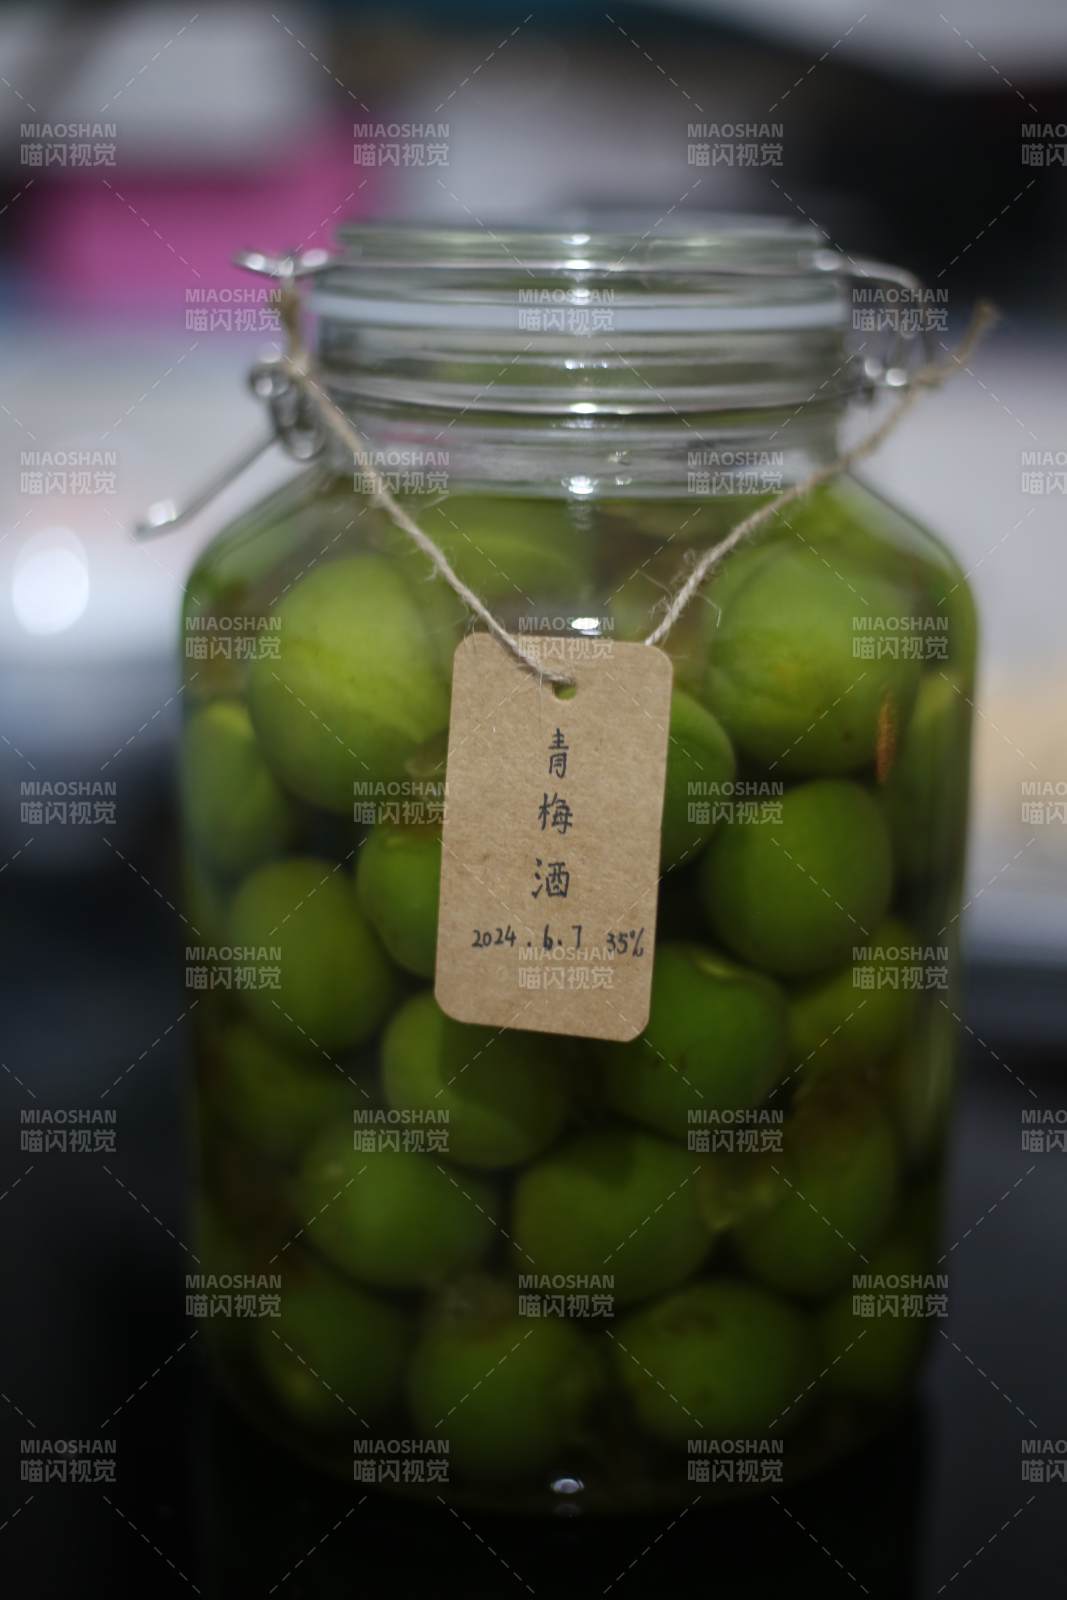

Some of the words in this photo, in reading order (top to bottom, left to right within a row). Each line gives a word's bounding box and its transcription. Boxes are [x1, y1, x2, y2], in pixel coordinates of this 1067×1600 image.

[531, 727, 573, 899] 青梅酒
[606, 927, 645, 957] 35%
